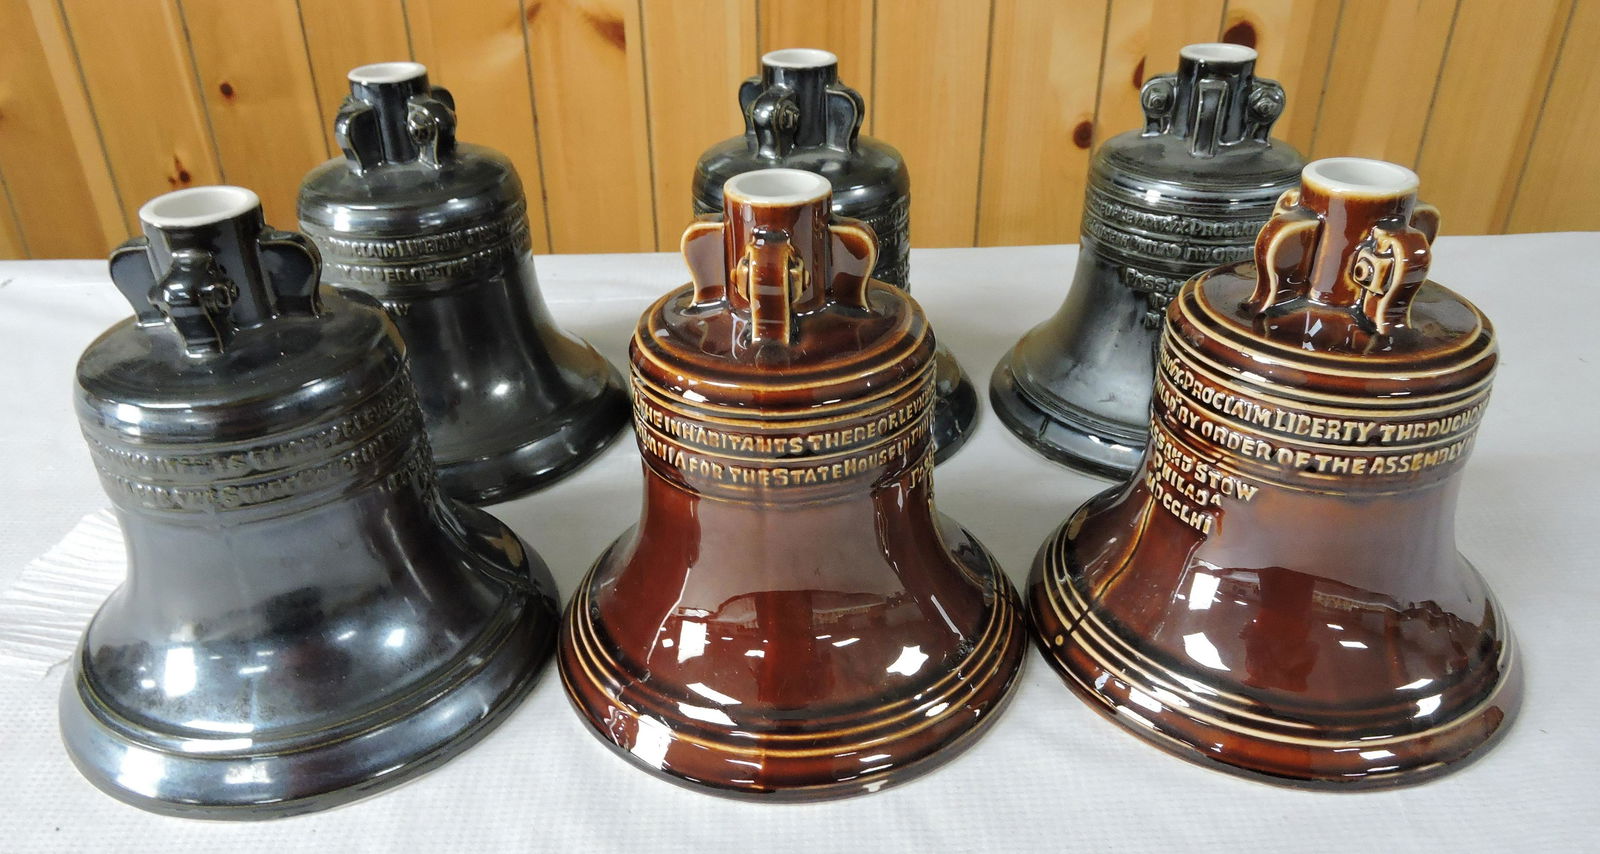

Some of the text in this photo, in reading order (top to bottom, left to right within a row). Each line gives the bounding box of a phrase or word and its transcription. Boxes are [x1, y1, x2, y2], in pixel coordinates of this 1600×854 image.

[1181, 371, 1272, 428] PROCLAIM
[1273, 408, 1376, 442] LIBERTY
[664, 415, 804, 453] INHABITANTS
[1178, 406, 1200, 429] BY
[1201, 421, 1272, 461] ORDER
[1277, 448, 1311, 468] OF
[1315, 454, 1368, 474] THE
[689, 457, 722, 479] FOR
[729, 466, 770, 487] THE
[772, 463, 842, 486] STATE
[1194, 461, 1260, 501] STOW
